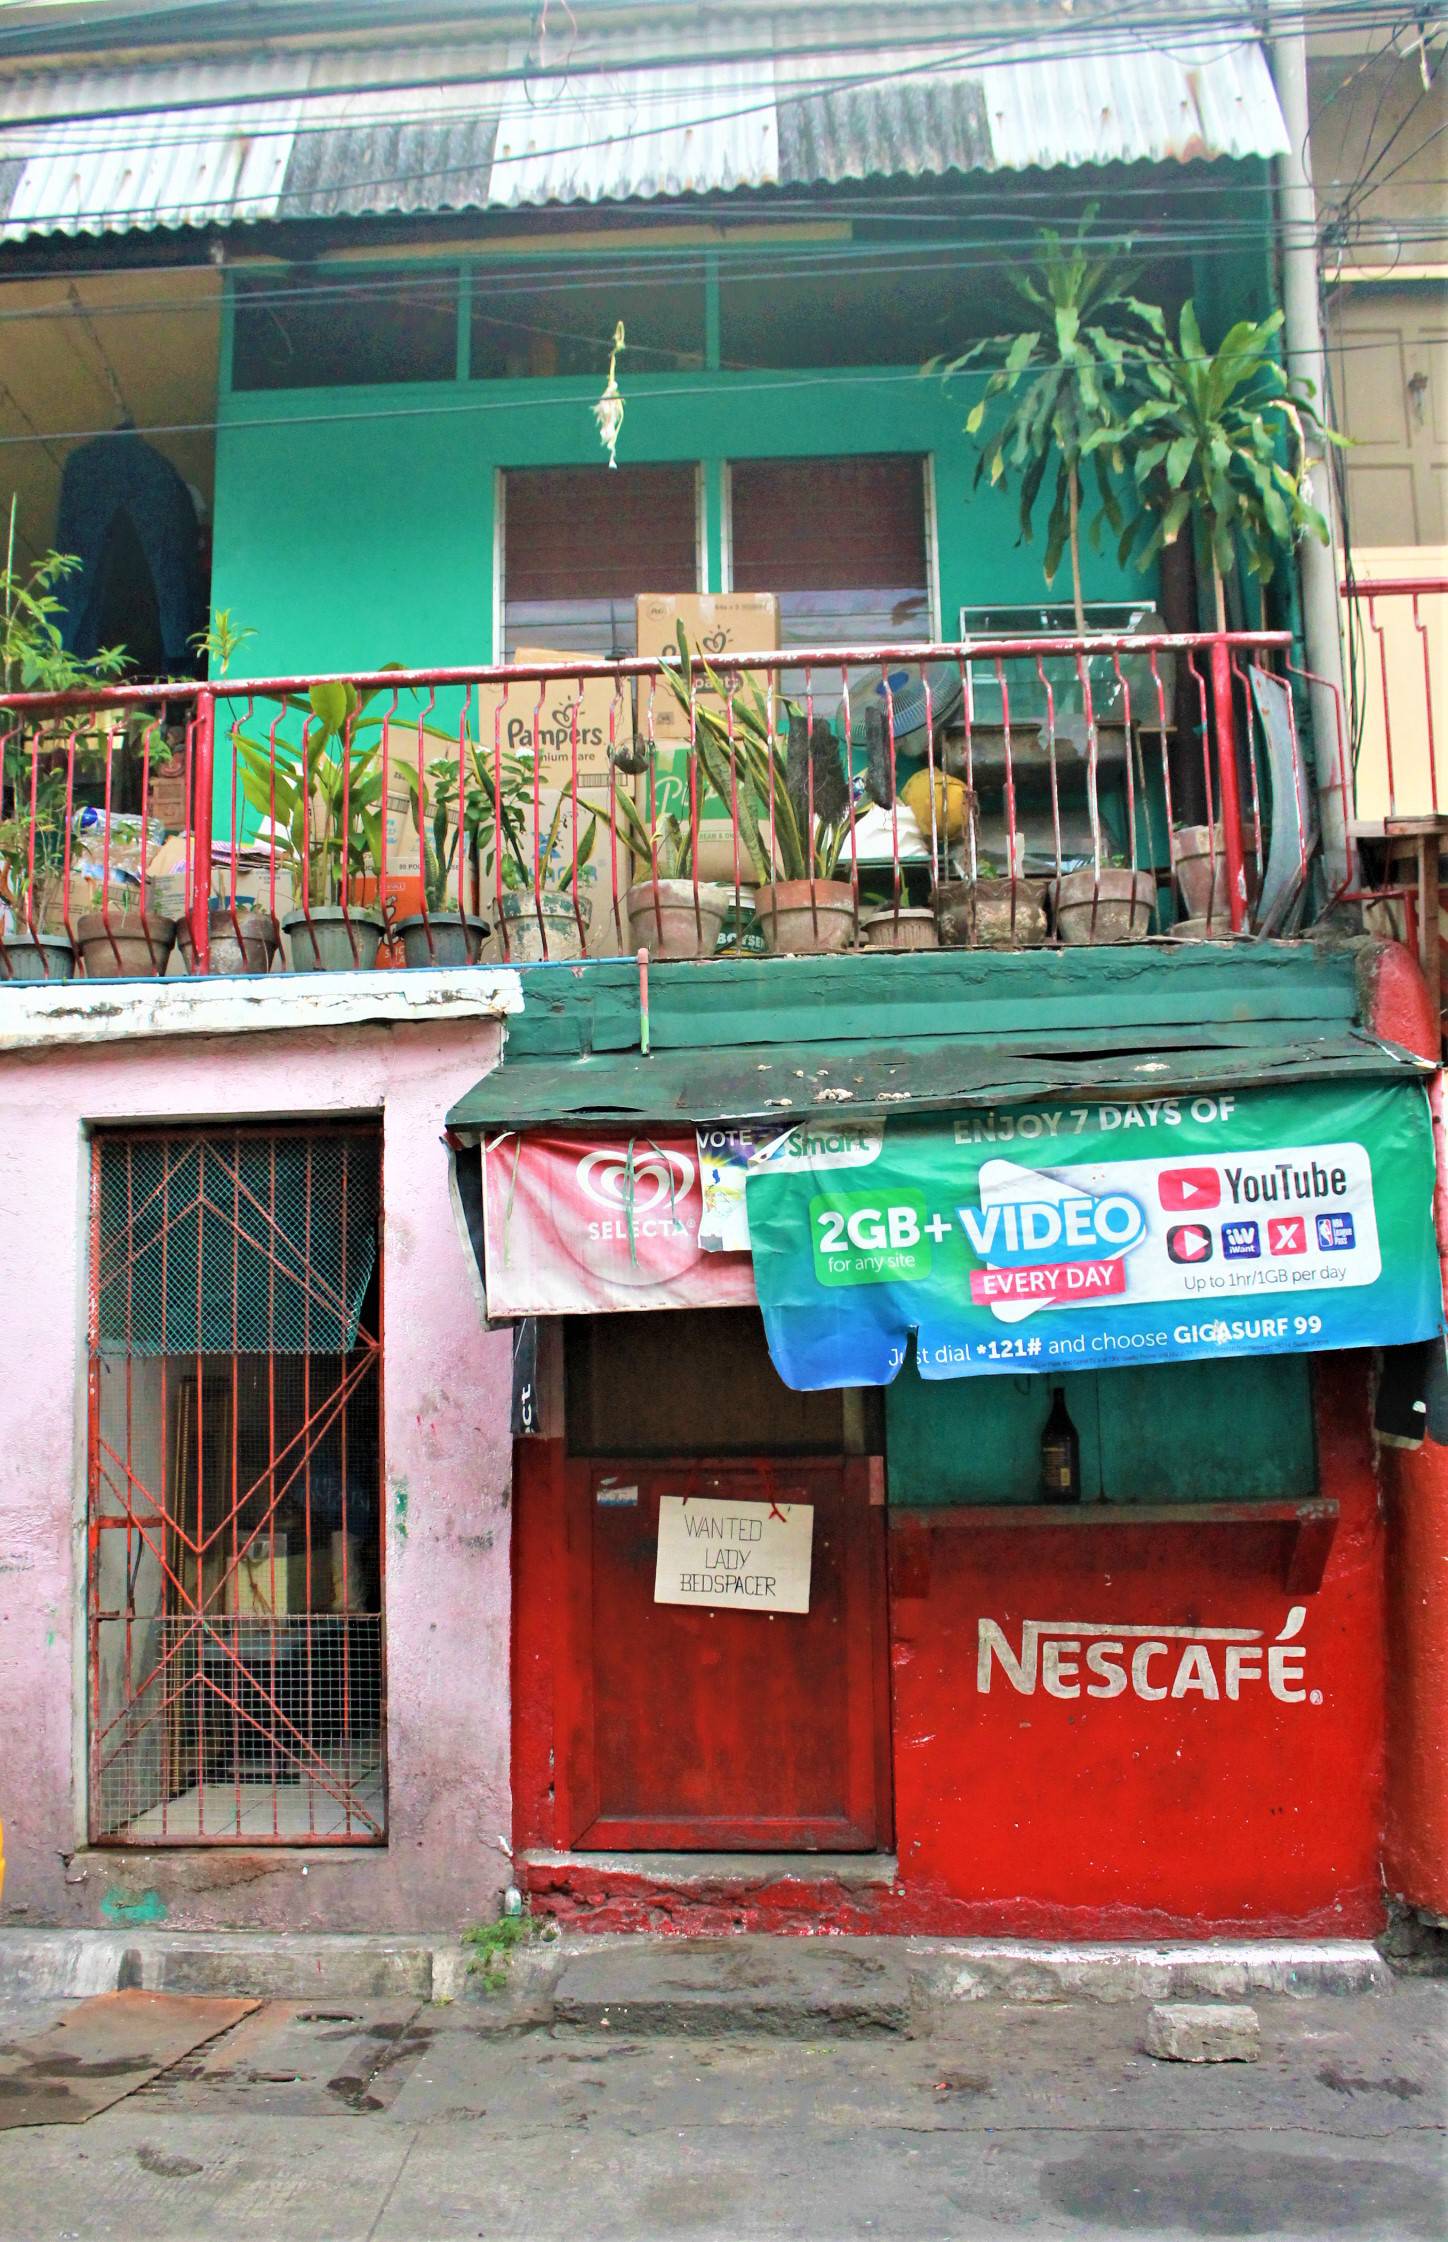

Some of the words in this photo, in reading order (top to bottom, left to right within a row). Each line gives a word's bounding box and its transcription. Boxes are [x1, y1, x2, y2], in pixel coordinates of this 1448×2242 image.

[507, 718, 602, 750] Pampers
[717, 932, 764, 949] BOSE
[954, 1111, 1062, 1145] ENJOY
[1070, 1109, 1089, 1134] 7
[1099, 1100, 1182, 1131] DAYS
[1191, 1096, 1235, 1123] OF
[699, 1130, 753, 1149] VOTE
[788, 1129, 871, 1157] Smart
[1224, 1161, 1347, 1204] YouTube
[588, 1219, 690, 1241] SELECTA
[959, 1196, 1141, 1254] VIDEO
[828, 1256, 851, 1273] for
[855, 1255, 883, 1273] any
[888, 1252, 916, 1268] site
[1229, 1245, 1256, 1254] iWant
[983, 1270, 1060, 1295] EVERY
[1067, 1265, 1114, 1288] DAY
[1185, 1276, 1207, 1292] Up
[1209, 1275, 1225, 1289] to
[1229, 1269, 1288, 1287] 1hr/1GB
[1292, 1269, 1318, 1286] per
[1320, 1265, 1347, 1282] day
[935, 1344, 971, 1363] dial
[1048, 1335, 1085, 1354] and
[1091, 1331, 1168, 1351] choose
[1174, 1317, 1289, 1345] GIGASURF
[1294, 1315, 1322, 1335] 99
[684, 1513, 763, 1542] WANTED
[705, 1548, 752, 1570] LADY
[680, 1573, 777, 1597] BEDSPACER
